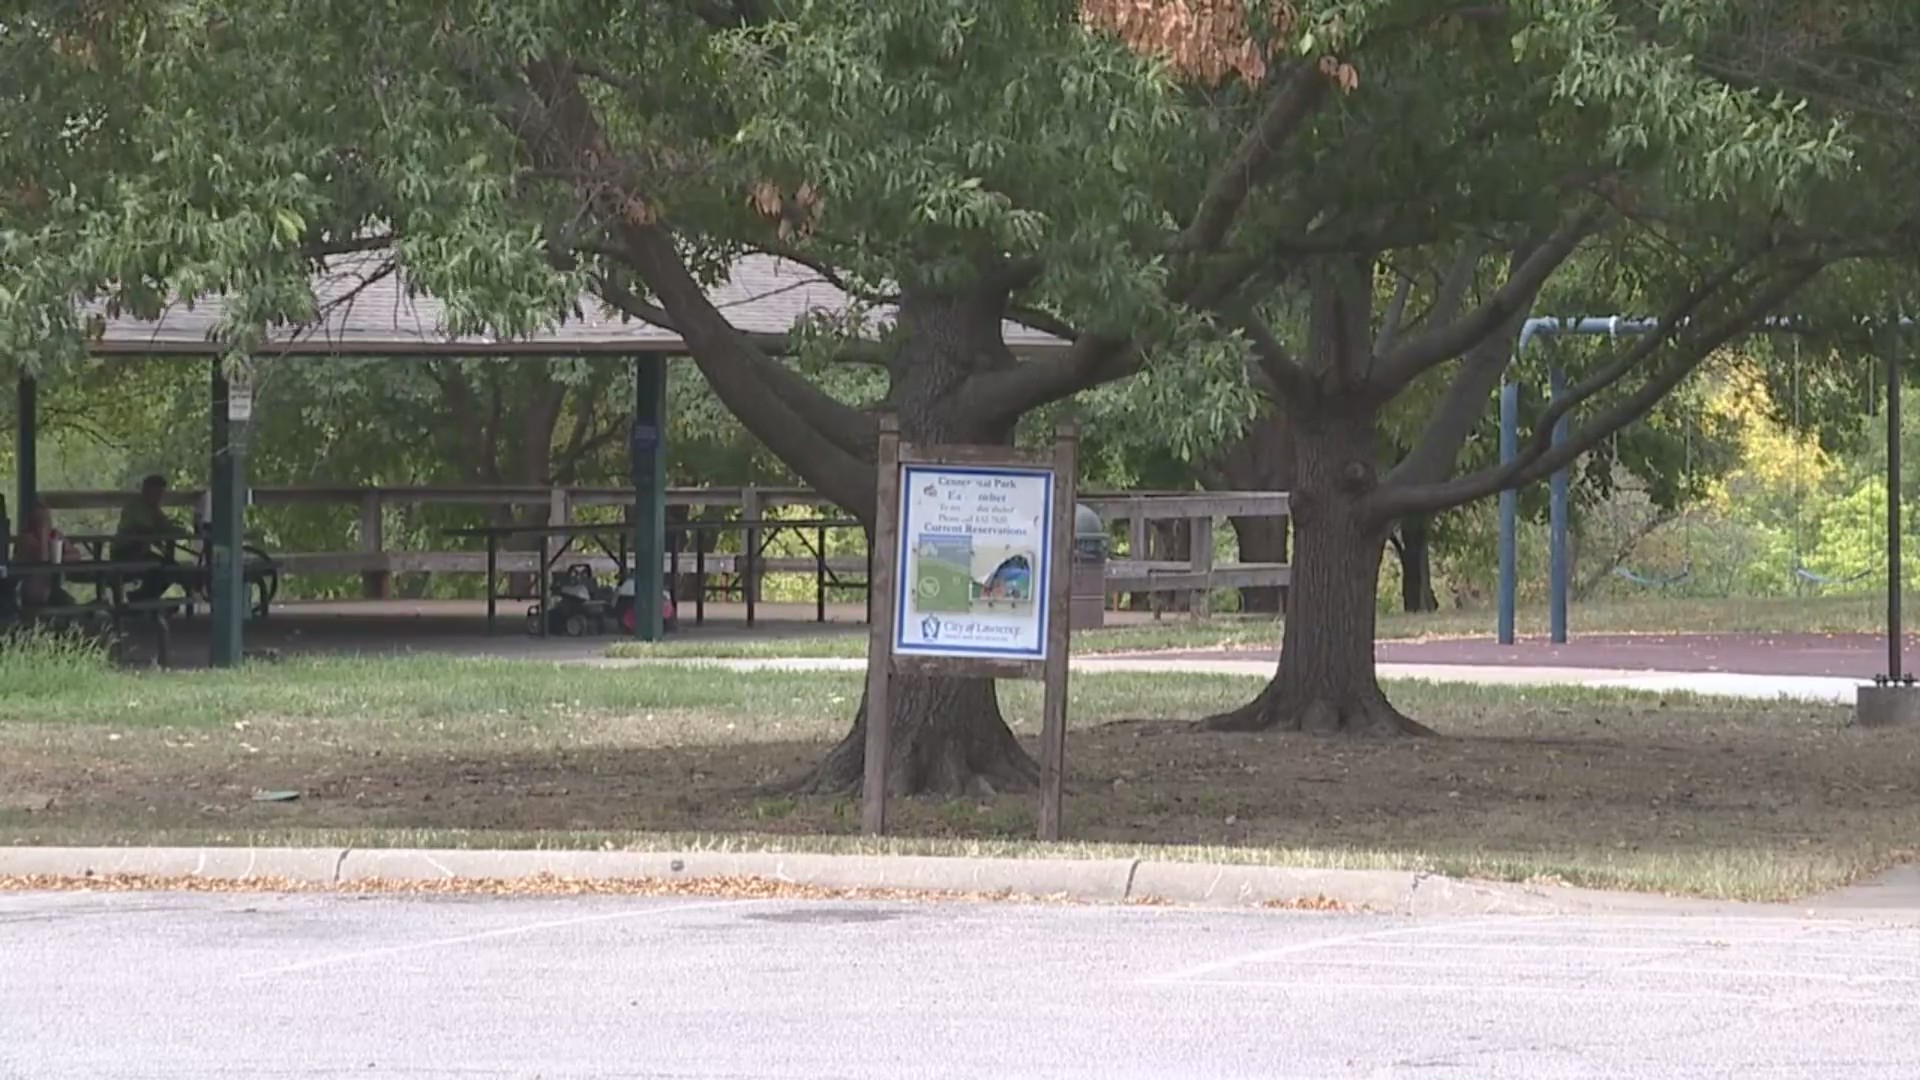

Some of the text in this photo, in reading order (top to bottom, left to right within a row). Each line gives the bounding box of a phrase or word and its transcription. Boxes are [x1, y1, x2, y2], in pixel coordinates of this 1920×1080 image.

[994, 478, 1017, 489] Park
[924, 522, 1027, 536] Current Reservations
[944, 621, 963, 633] City
[965, 621, 975, 633] of
